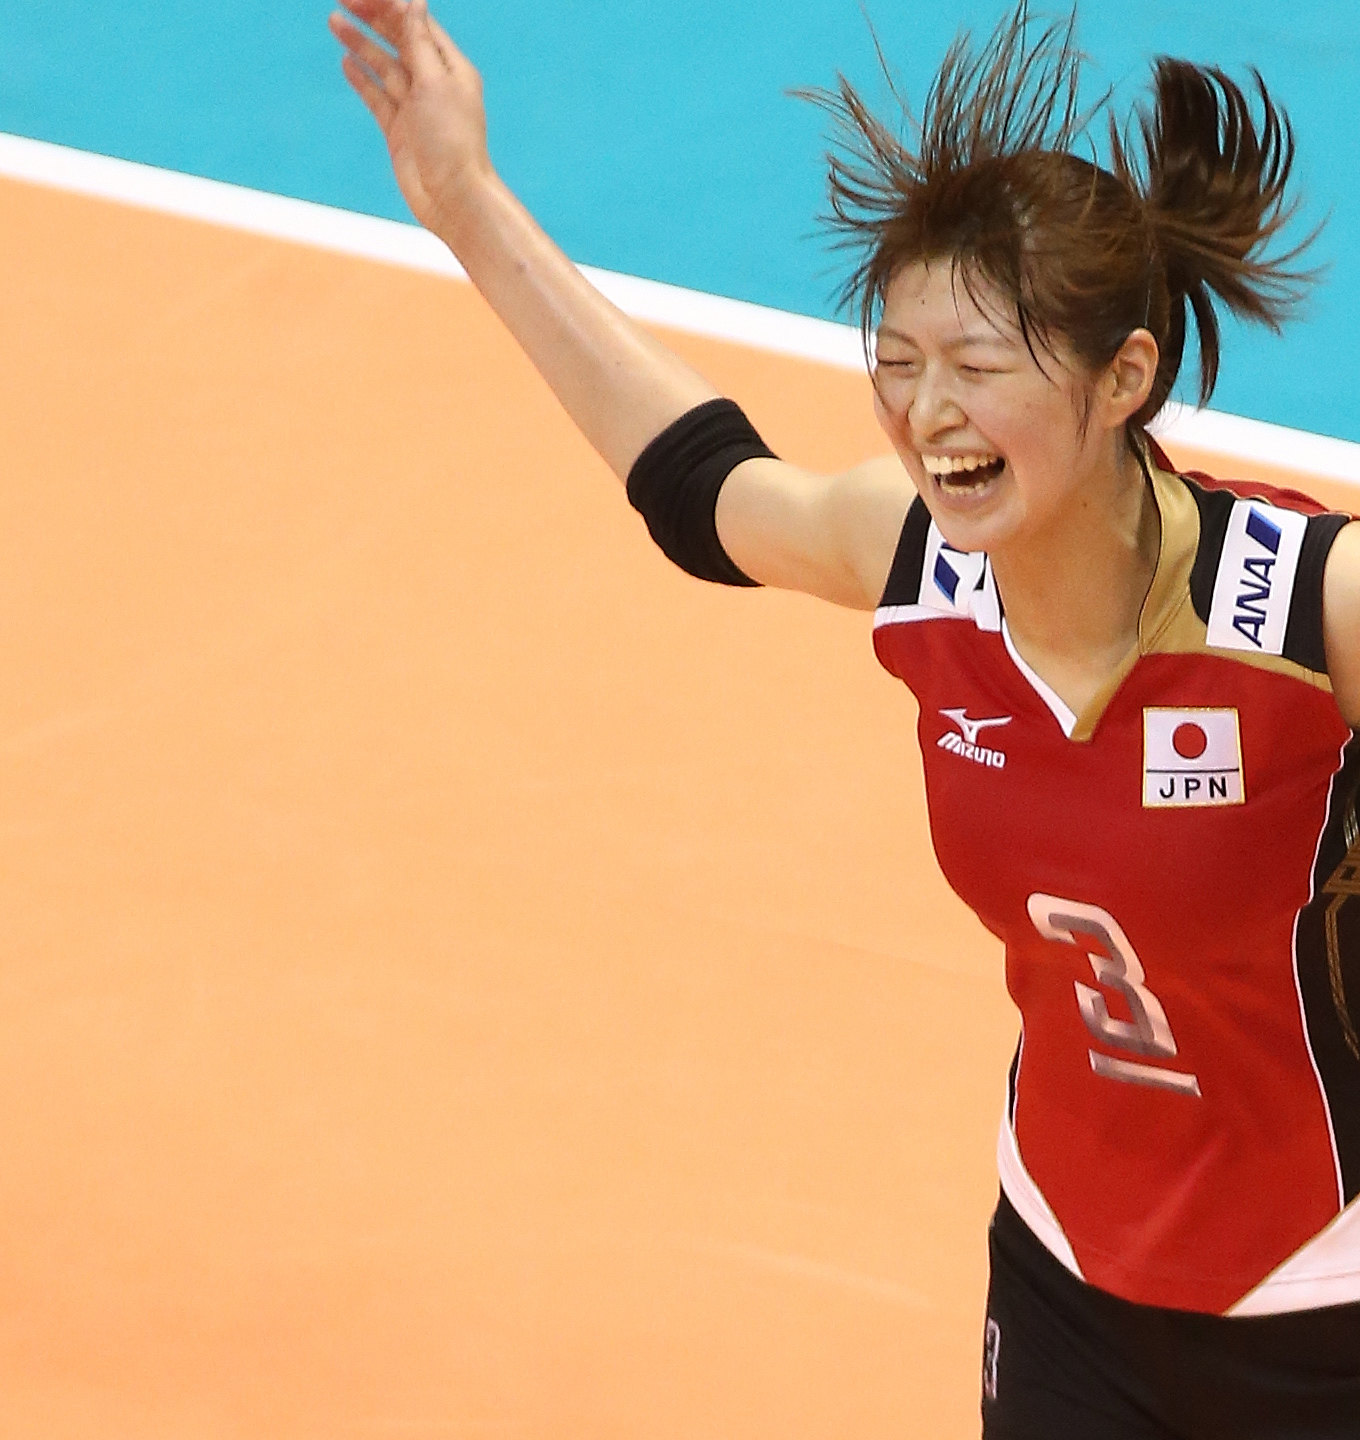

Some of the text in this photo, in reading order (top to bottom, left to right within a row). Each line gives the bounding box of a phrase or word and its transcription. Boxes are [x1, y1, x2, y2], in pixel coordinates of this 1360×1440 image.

[1232, 557, 1277, 648] ANA
[1159, 776, 1227, 799] JPN
[1027, 892, 1178, 1057] 3
